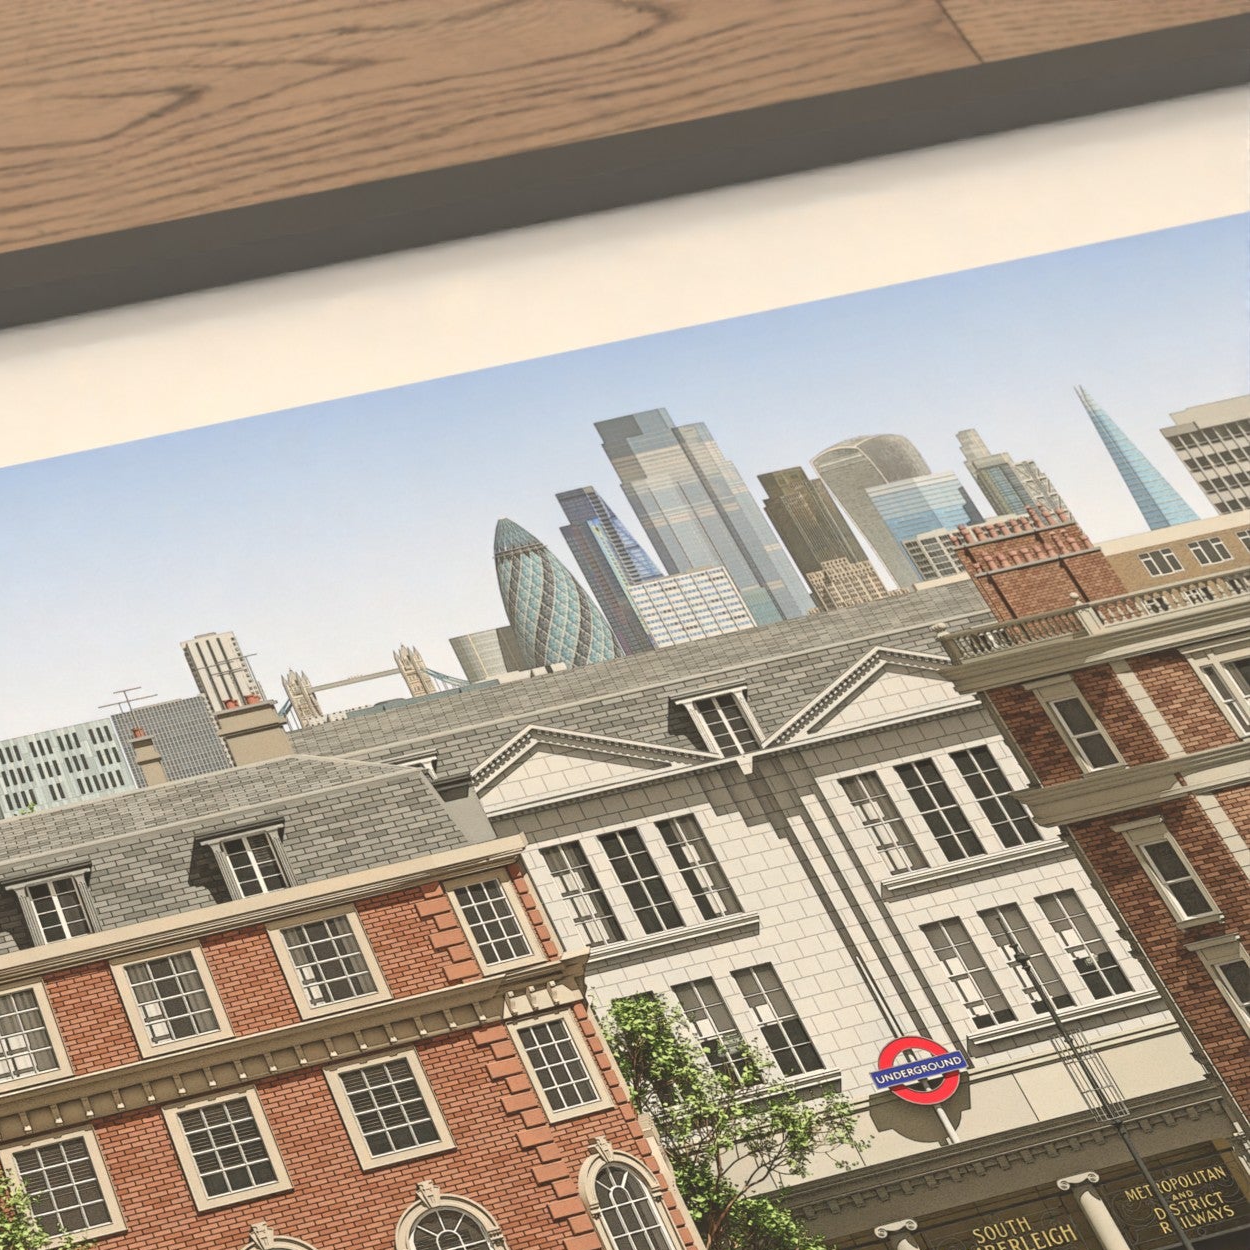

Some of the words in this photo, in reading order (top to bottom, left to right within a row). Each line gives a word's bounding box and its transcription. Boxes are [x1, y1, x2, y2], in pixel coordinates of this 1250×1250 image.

[875, 1056, 962, 1084] UNDERGROUND
[1154, 1191, 1225, 1221] DSTRICT
[1171, 1189, 1194, 1201] AND
[972, 1216, 1032, 1244] SOUTH
[1159, 1204, 1235, 1235] RILWAYS
